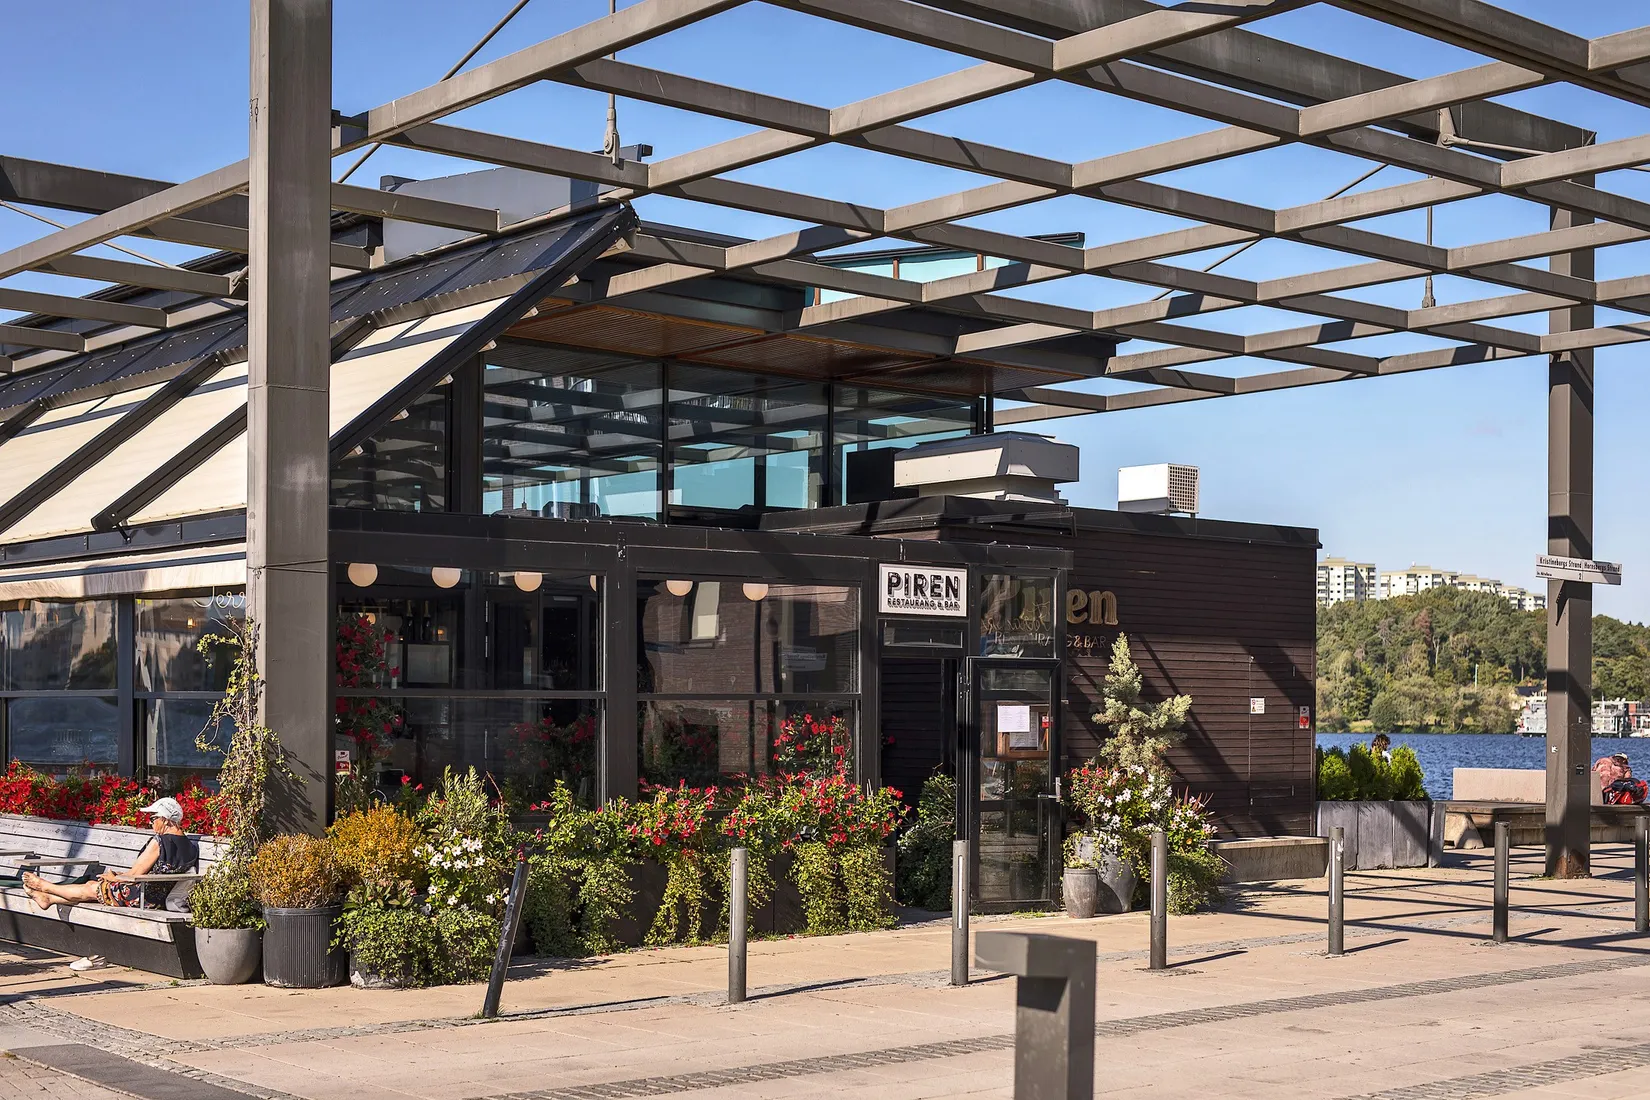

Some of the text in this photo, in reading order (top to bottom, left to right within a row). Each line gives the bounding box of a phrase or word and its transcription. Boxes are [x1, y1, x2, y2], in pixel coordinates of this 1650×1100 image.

[1569, 559, 1581, 568] Strand
[1607, 563, 1619, 573] Strand
[887, 571, 960, 601] PIREN
[887, 598, 960, 611] RESTAURANG & BAR
